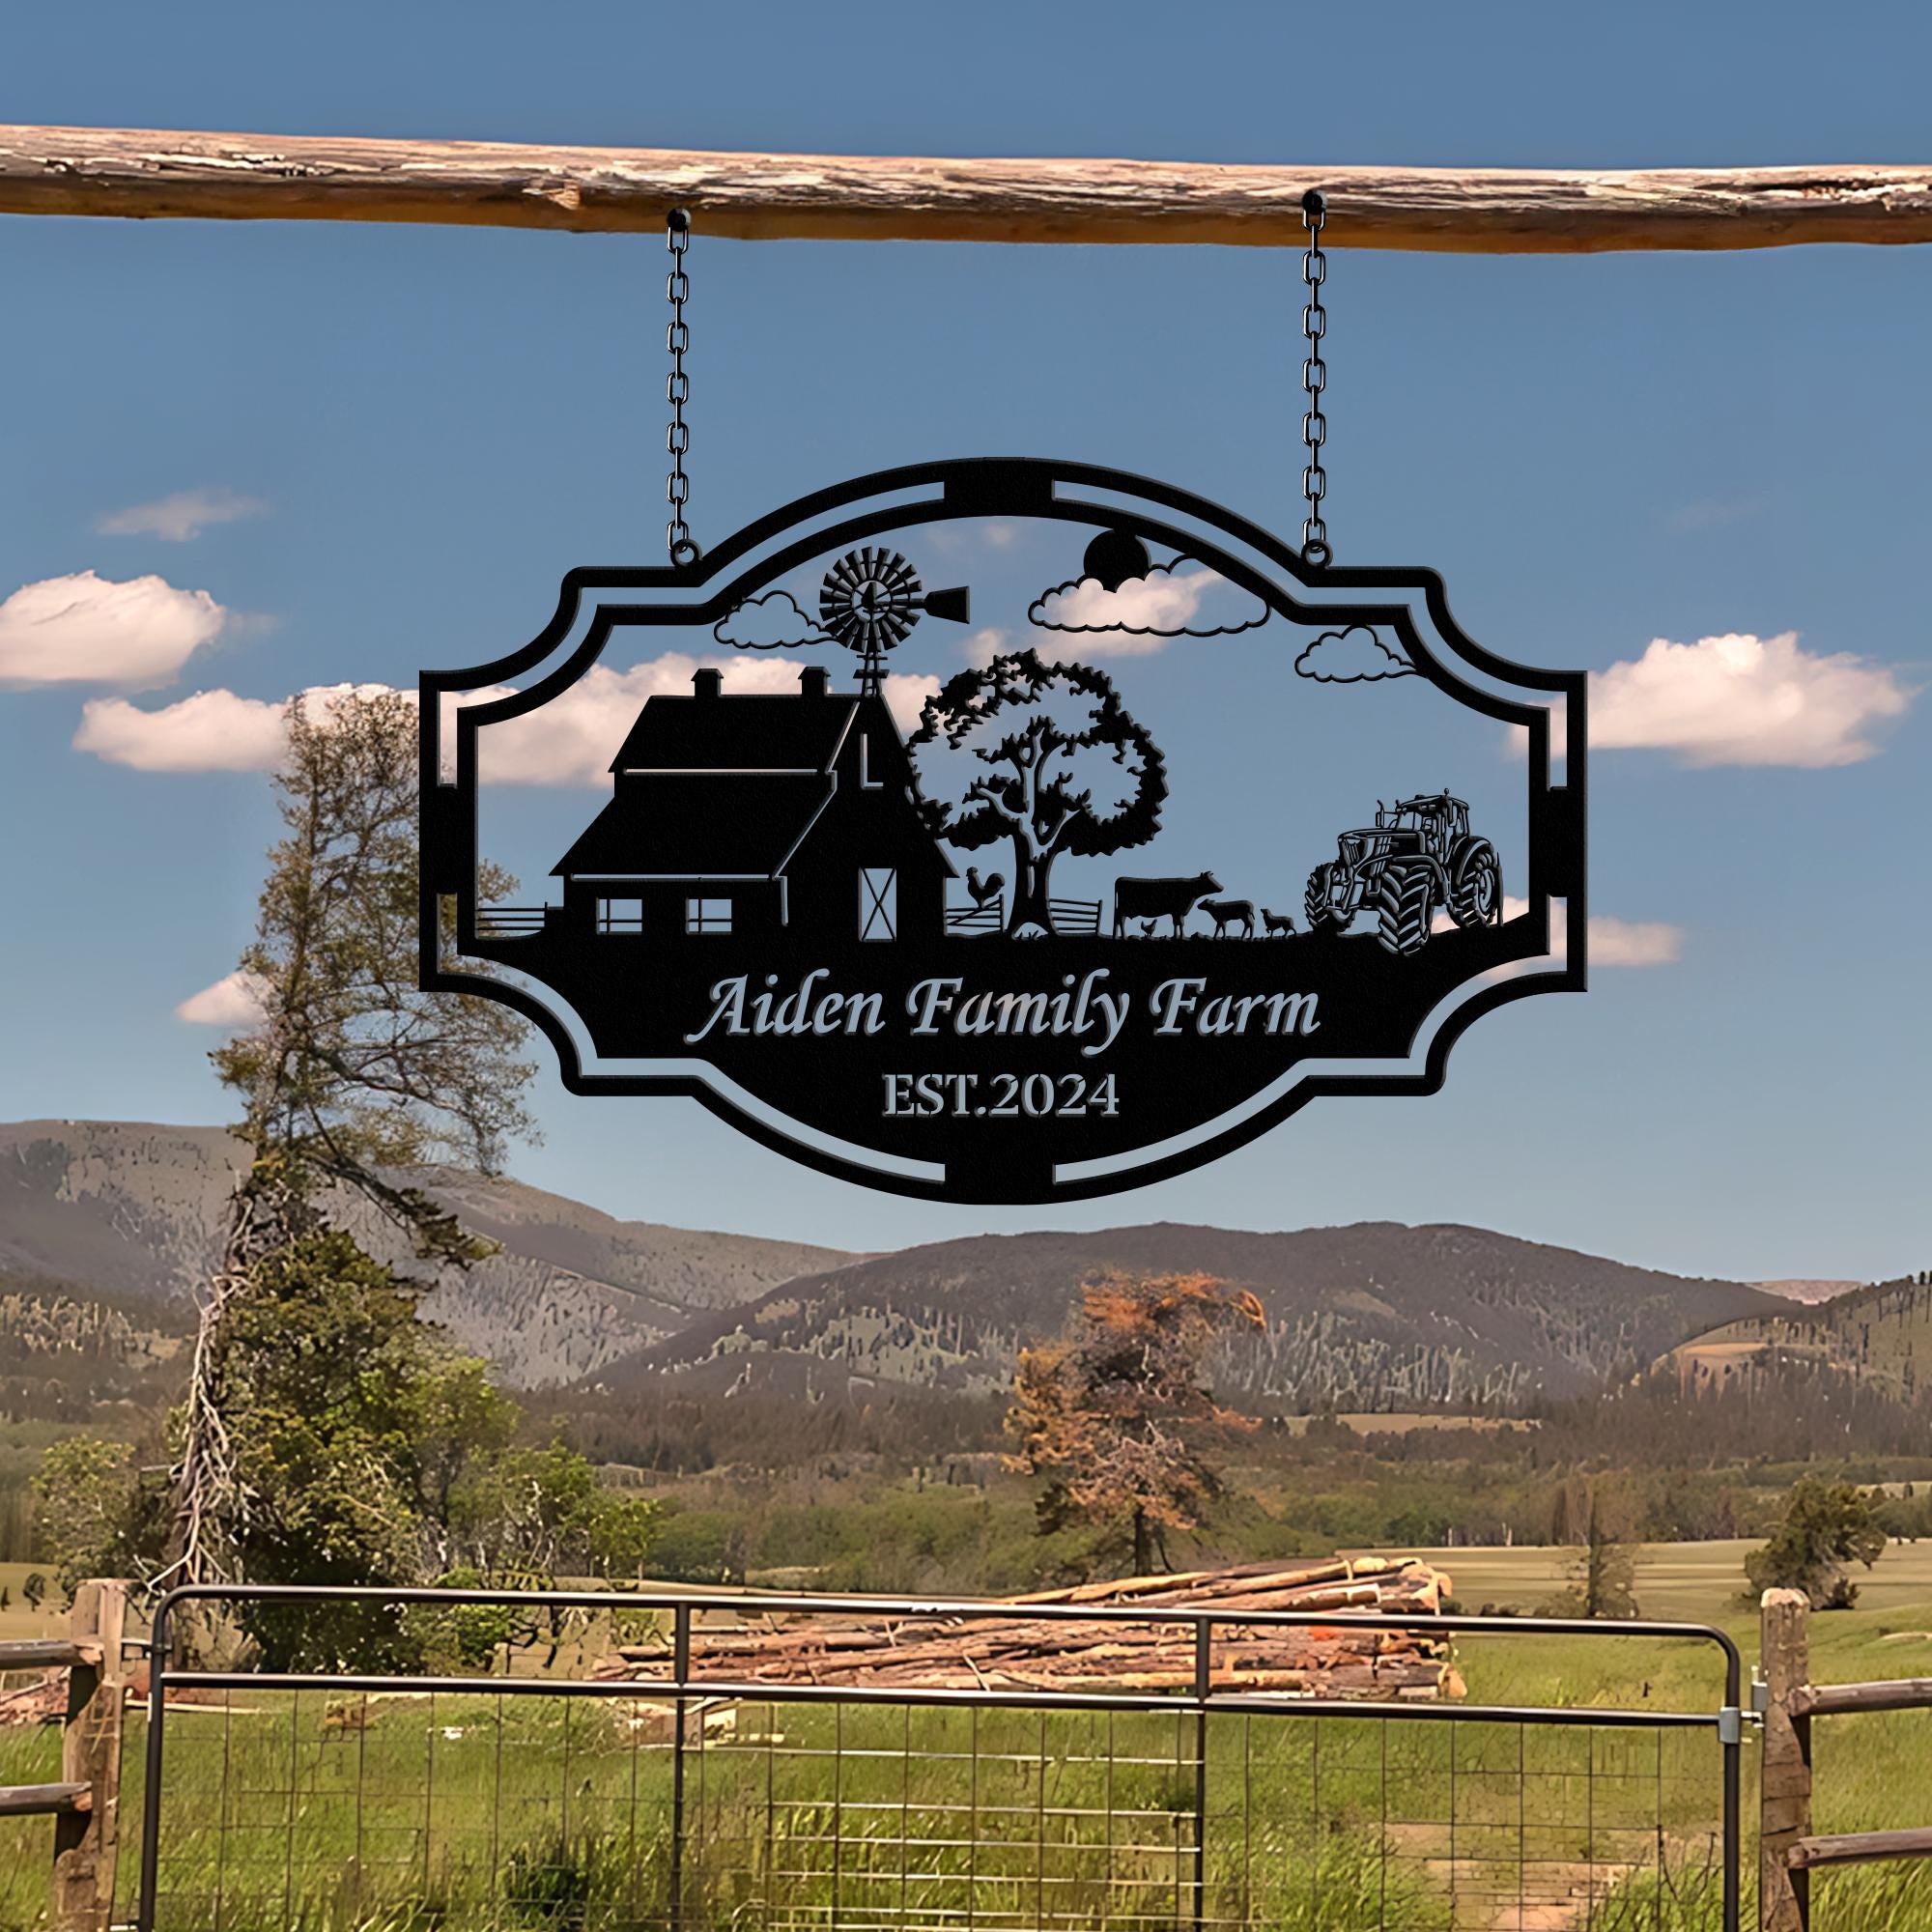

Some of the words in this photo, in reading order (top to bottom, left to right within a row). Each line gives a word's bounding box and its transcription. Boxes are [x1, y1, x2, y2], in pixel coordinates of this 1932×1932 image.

[684, 968, 886, 1043] Aiden
[906, 968, 1130, 1056] Family
[1150, 977, 1321, 1036] Farm
[883, 1073, 1120, 1116] EST.2024
